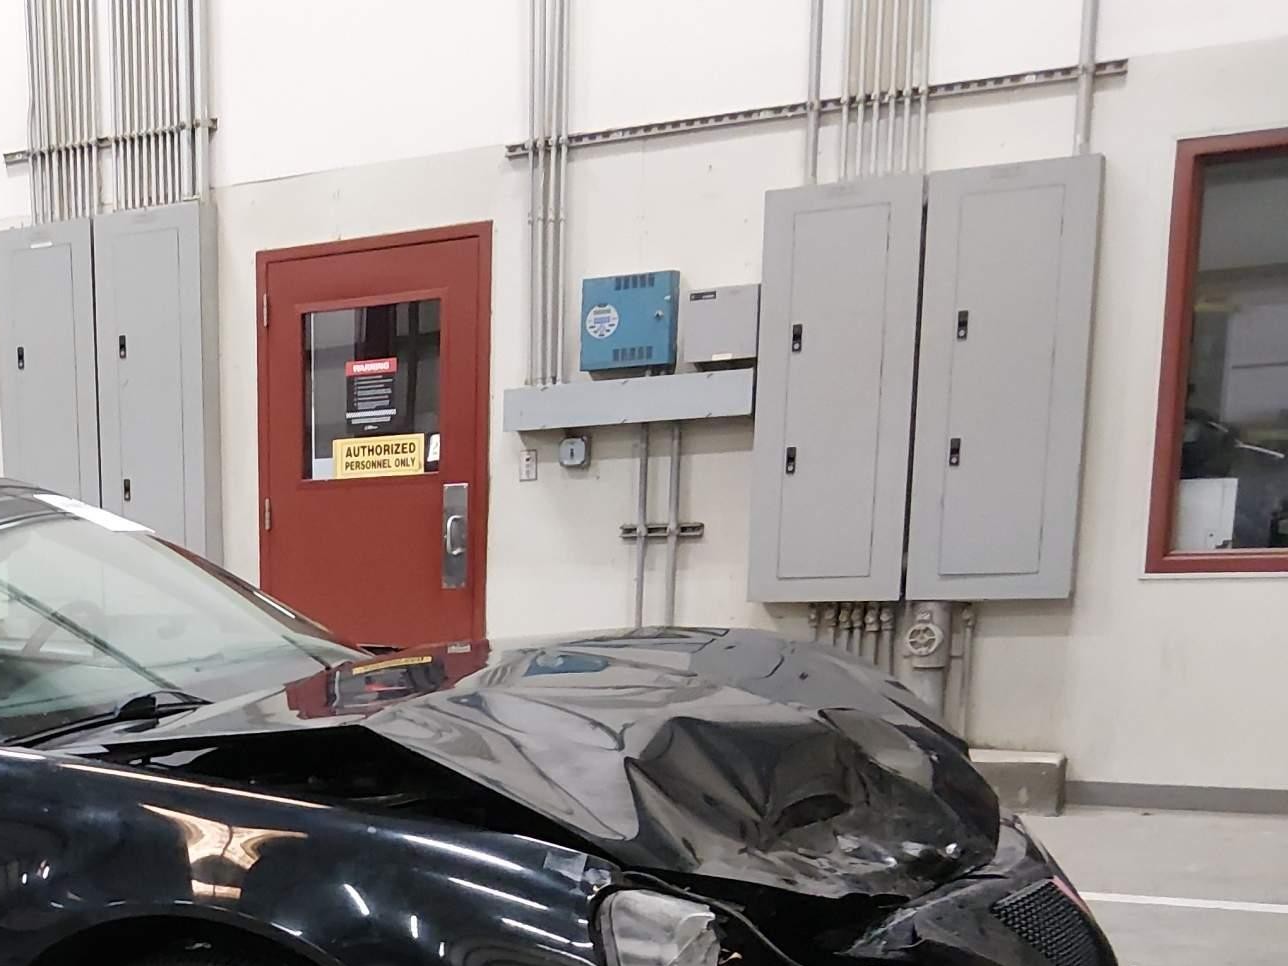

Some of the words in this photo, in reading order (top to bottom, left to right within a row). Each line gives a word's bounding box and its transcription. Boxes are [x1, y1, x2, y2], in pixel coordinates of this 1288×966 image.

[345, 442, 417, 458] AUTHORIZED
[344, 459, 392, 471] PERSONNEL
[394, 457, 416, 468] ONLY
